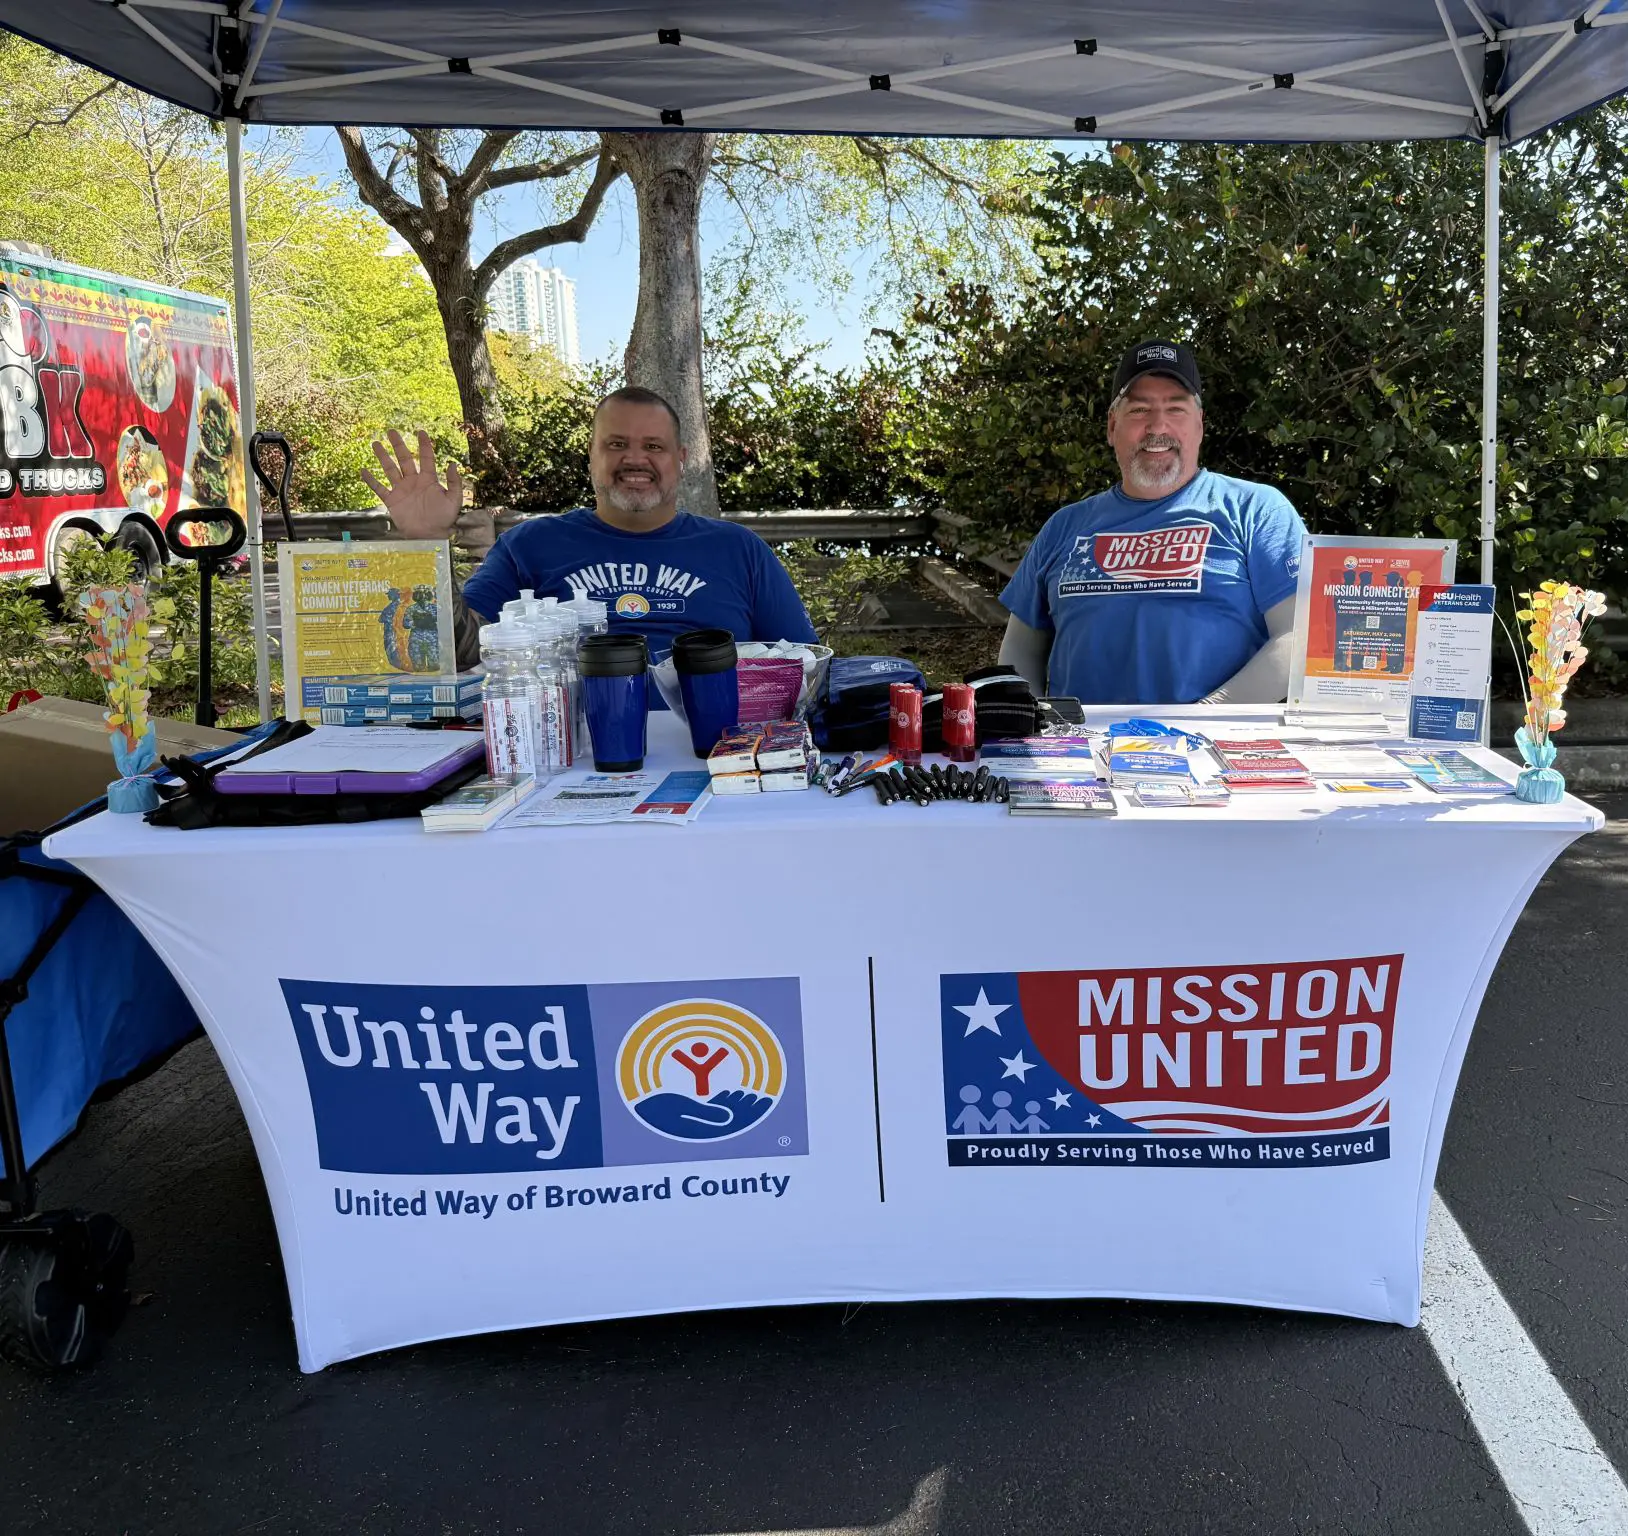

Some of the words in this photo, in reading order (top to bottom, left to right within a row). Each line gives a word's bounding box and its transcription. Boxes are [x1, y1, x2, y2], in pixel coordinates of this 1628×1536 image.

[20, 468, 104, 491] TRUCKS
[1109, 529, 1205, 552] MISSION
[1103, 544, 1200, 568] UNITED
[302, 582, 340, 594] WOMEN
[342, 580, 390, 593] VETERANS
[564, 562, 648, 593] UNITED
[656, 564, 707, 598] WAY
[646, 586, 674, 598] COUNTY
[1062, 584, 1084, 592] Proudly
[1167, 580, 1192, 588] Served
[1324, 584, 1360, 596] MISSION
[1363, 585, 1403, 598] CONNECT
[303, 596, 360, 610] COMMITTEE
[1078, 964, 1390, 1026] MISSION
[301, 1003, 579, 1071] United
[1079, 1022, 1382, 1089] UNITED
[420, 1082, 580, 1160] Way
[968, 1144, 1050, 1161] Proudly
[1058, 1144, 1137, 1162] Serving
[1143, 1144, 1202, 1160] Those
[1208, 1144, 1251, 1160] Who
[1258, 1144, 1304, 1160] Have
[1312, 1137, 1375, 1158] Served
[334, 1188, 426, 1217] United
[435, 1190, 498, 1220] Way
[506, 1186, 538, 1211] of
[545, 1176, 672, 1208] Broward
[681, 1171, 790, 1198] County
